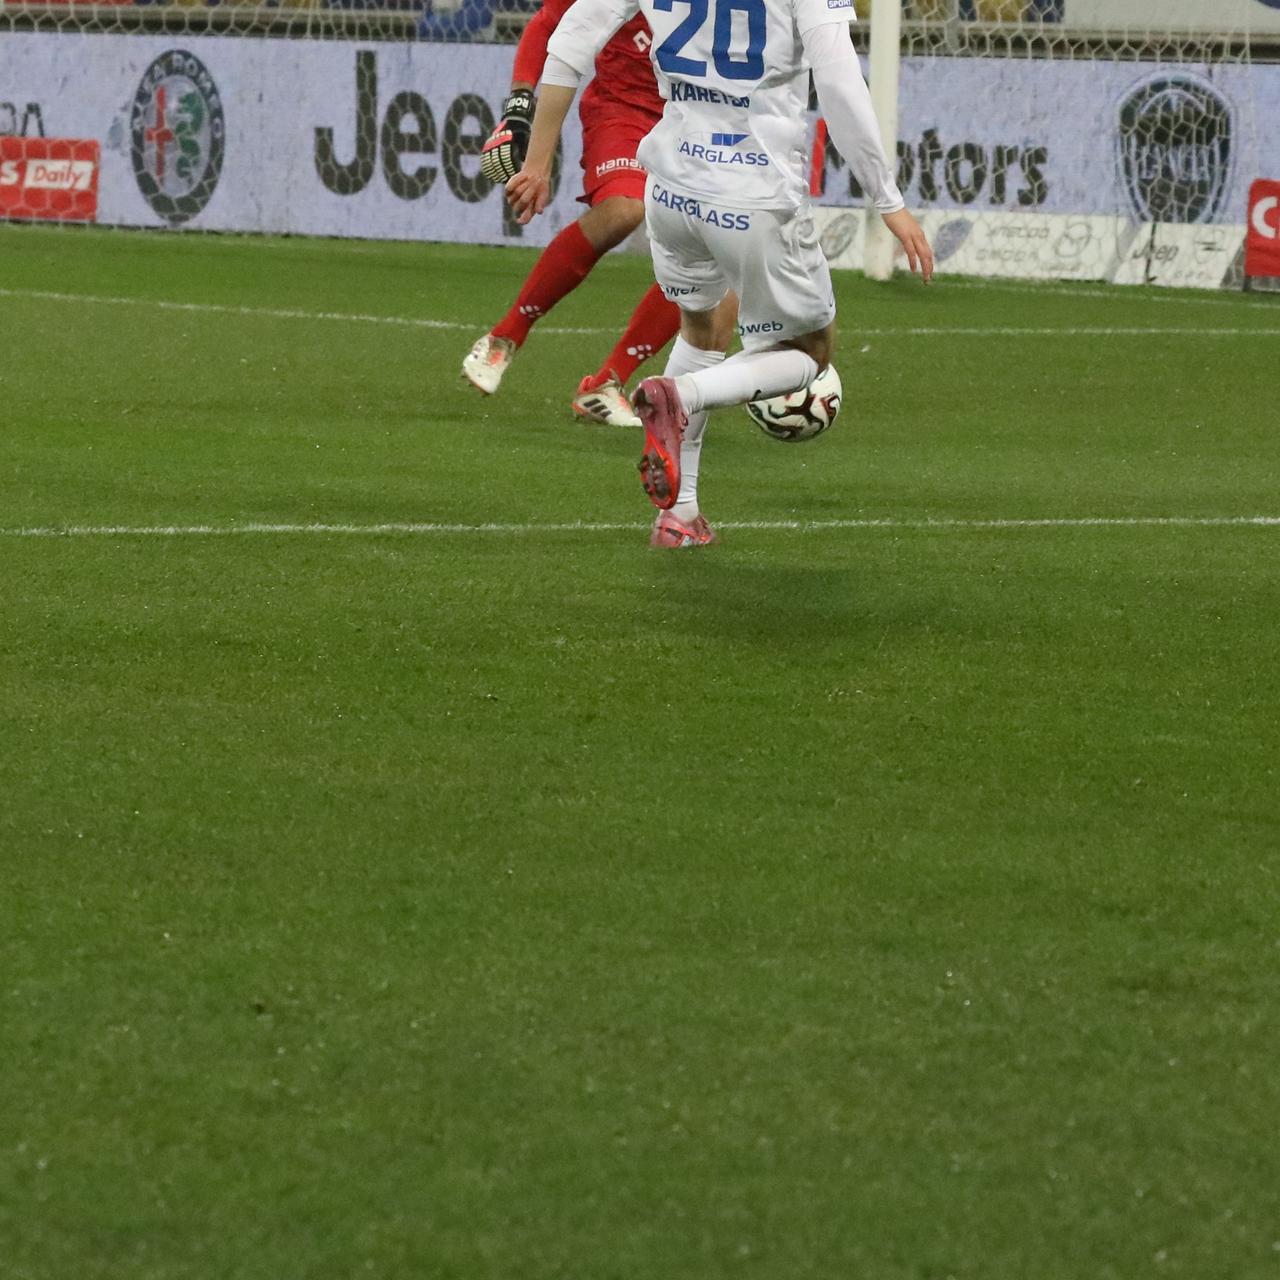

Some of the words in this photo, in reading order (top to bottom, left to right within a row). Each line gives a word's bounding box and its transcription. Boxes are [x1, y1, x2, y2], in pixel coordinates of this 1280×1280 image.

[596, 157, 646, 175] Hama
[678, 139, 769, 167] ARGLASS
[32, 162, 84, 188] Daily
[652, 184, 750, 231] CARGLASS
